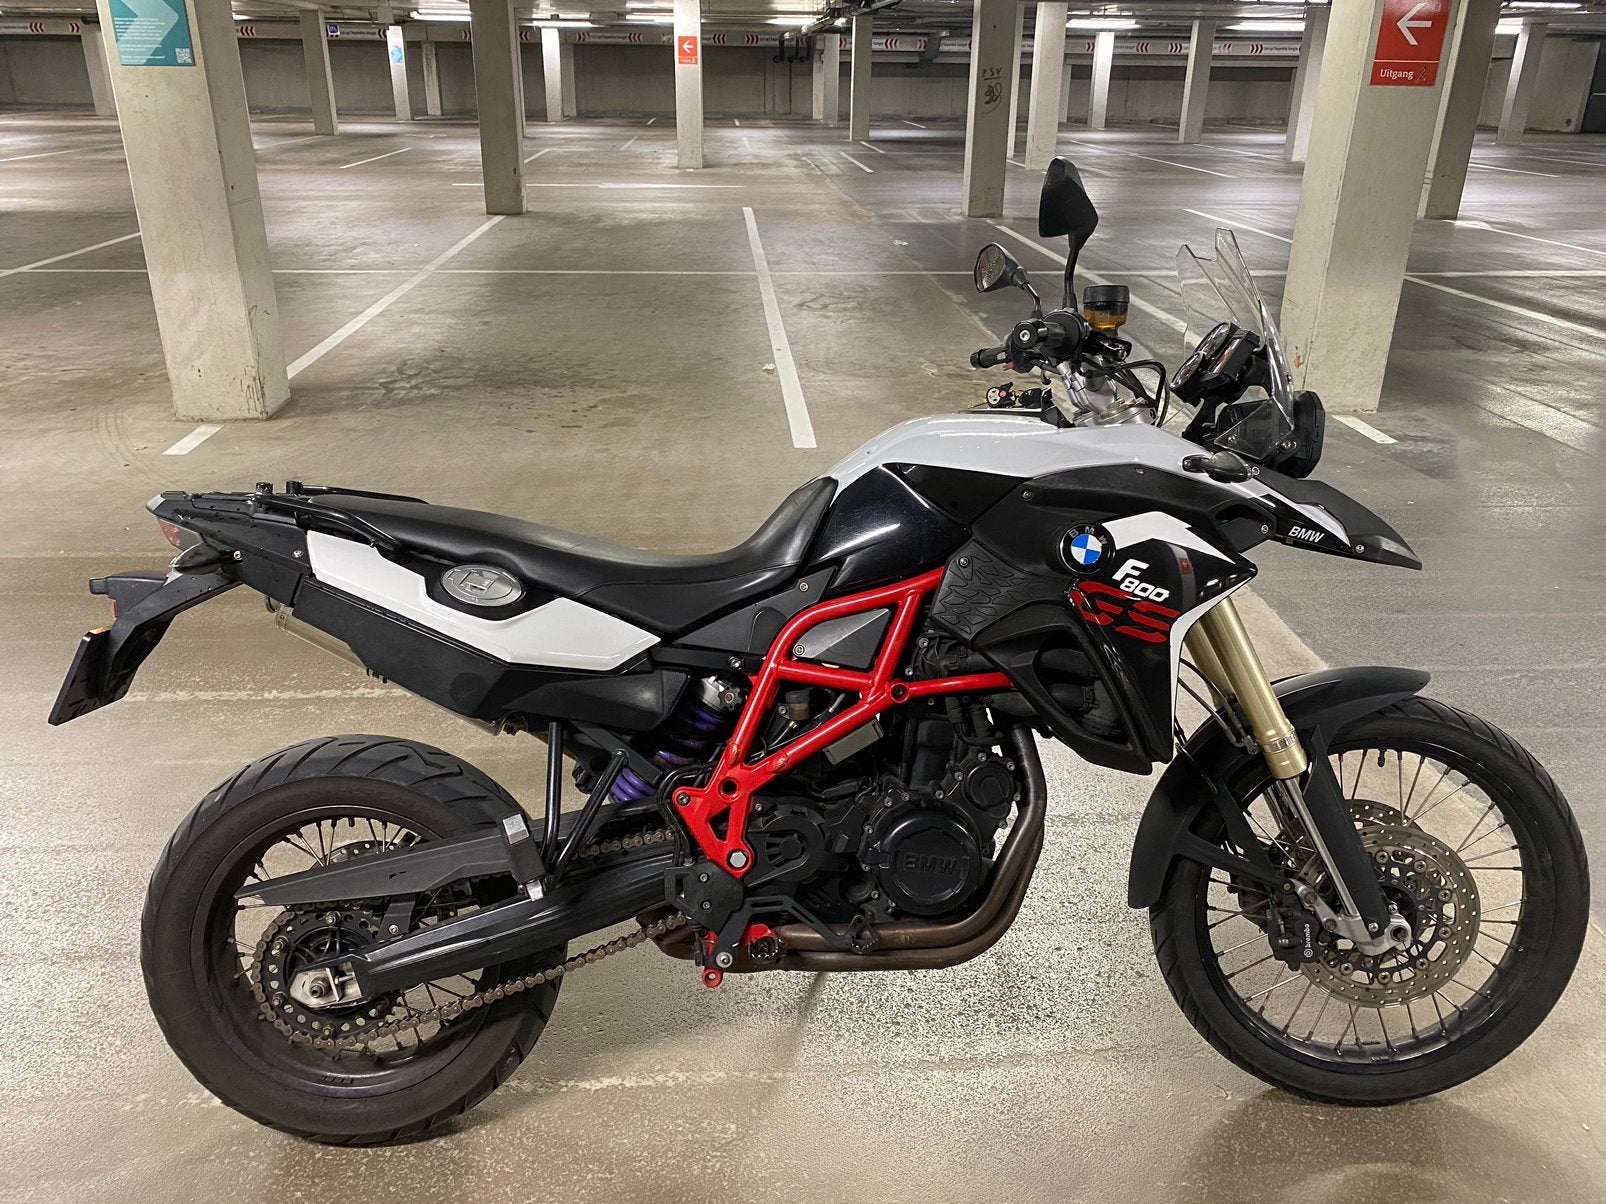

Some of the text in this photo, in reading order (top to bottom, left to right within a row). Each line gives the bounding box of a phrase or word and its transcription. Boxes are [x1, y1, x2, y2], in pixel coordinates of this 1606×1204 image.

[1380, 68, 1415, 80] Uitgang
[1068, 525, 1109, 546] BMW
[1288, 525, 1325, 543] BMW
[1111, 558, 1171, 602] F 800
[902, 853, 959, 874] BMW
[1303, 923, 1312, 948] brembo
